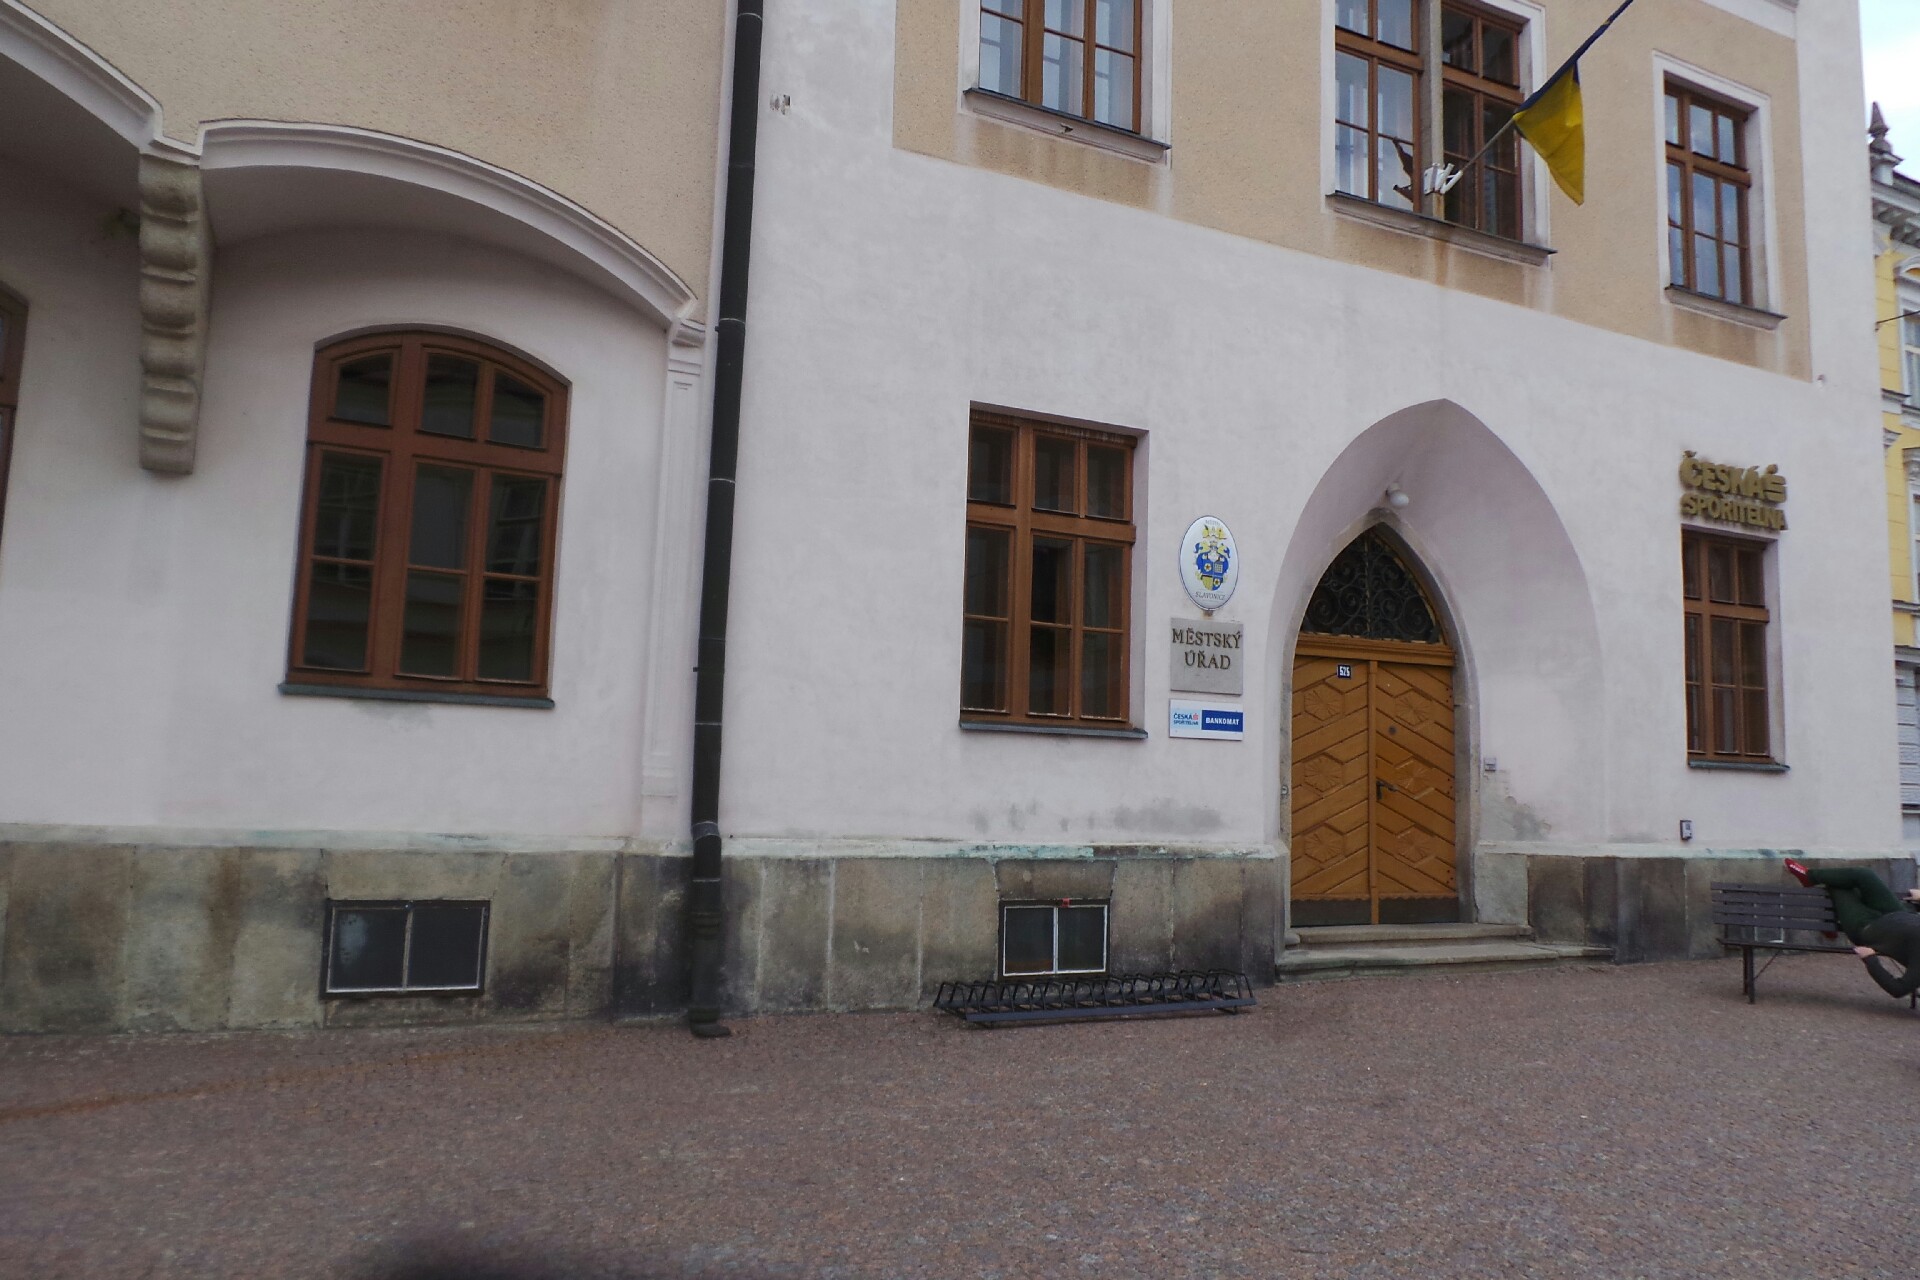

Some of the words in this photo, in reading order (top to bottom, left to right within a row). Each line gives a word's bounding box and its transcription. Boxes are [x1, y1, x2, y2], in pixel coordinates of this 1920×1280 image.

[1679, 450, 1761, 499] ČESKÁ
[1172, 627, 1242, 649] MĚSTSKÝ
[1173, 712, 1192, 720] ČESKÁ
[1205, 717, 1240, 726] BANKOMAT
